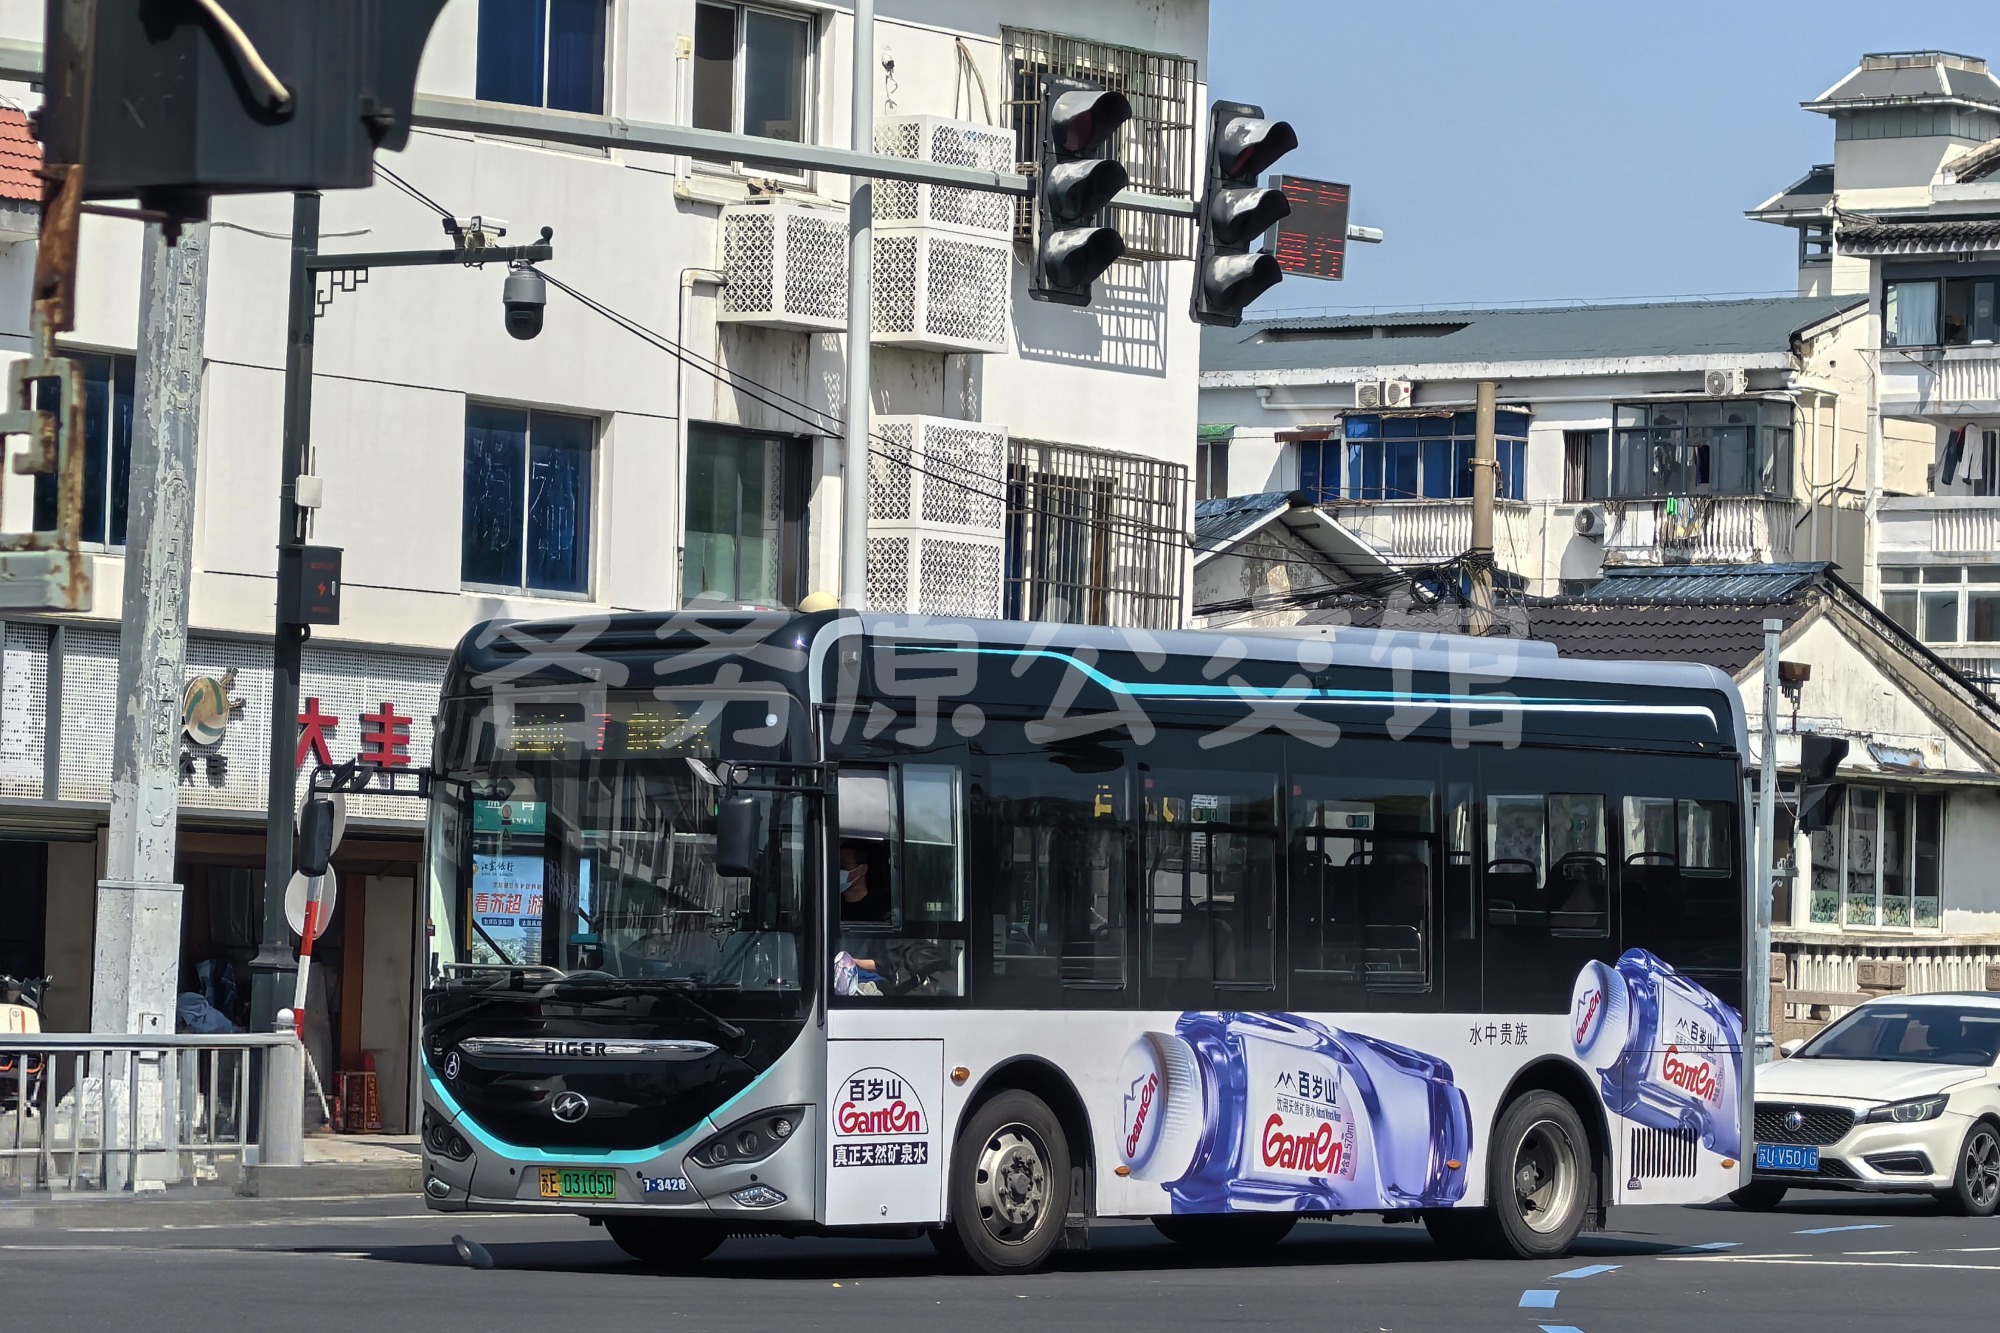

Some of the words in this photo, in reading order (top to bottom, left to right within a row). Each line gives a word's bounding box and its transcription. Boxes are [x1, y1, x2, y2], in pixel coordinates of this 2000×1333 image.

[475, 892, 522, 915] 看苏超
[1469, 1021, 1528, 1046] 水中贵族
[1690, 1021, 1715, 1052] 百岁山
[545, 1041, 607, 1057] HIGER
[849, 1078, 902, 1101] 百岁山
[1298, 1070, 1337, 1105] 百岁山
[834, 1143, 927, 1166] 真正天然矿泉水
[541, 1173, 558, 1193] 苏E
[564, 1173, 615, 1194] 03105D
